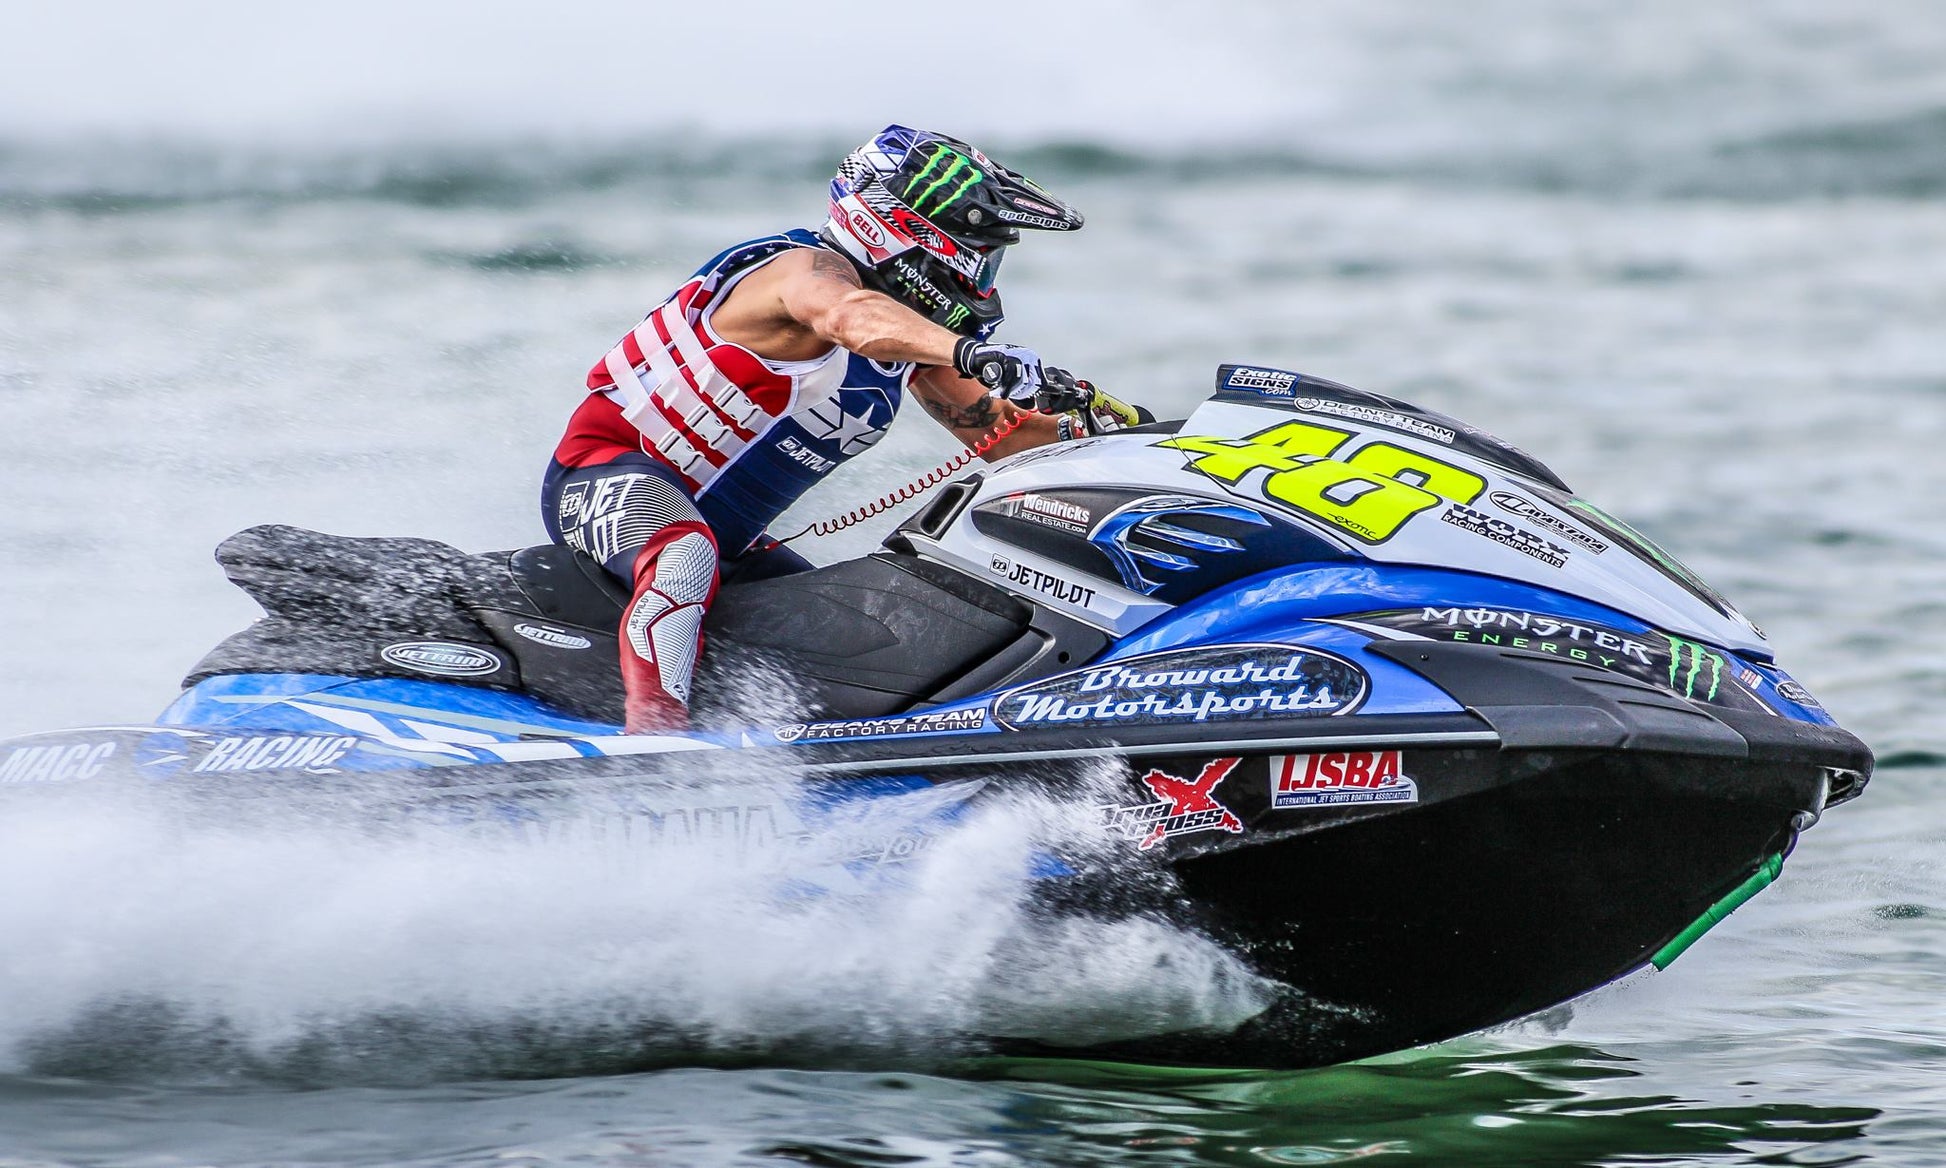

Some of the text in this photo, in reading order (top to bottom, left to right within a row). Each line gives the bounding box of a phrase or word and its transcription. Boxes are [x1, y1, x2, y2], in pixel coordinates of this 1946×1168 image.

[852, 213, 881, 243] BELL
[1230, 376, 1290, 390] SIGNS
[1233, 367, 1297, 381] Exotic
[1319, 406, 1452, 444] FACTORY RACING
[1323, 400, 1455, 438] DEAN'S TEAM
[579, 473, 648, 526] JET
[1020, 511, 1042, 524] REAL
[1022, 493, 1091, 523] Wendricks
[1442, 514, 1488, 535] RACING
[1487, 530, 1564, 569] COMPONENTS
[1008, 563, 1096, 608] JETPILOT
[1453, 630, 1616, 667] ENERGY
[1079, 655, 1303, 693] Broward
[911, 707, 987, 724] TEAM
[1014, 686, 1340, 722] Motorsports
[806, 719, 983, 739] FACTORY RACING
[0, 736, 357, 783] MACC RACING
[1278, 750, 1399, 792] IJSBA
[1329, 794, 1350, 803] SPORTS
[1350, 792, 1374, 802] BOATING
[1374, 790, 1410, 801] ASSOCIATION
